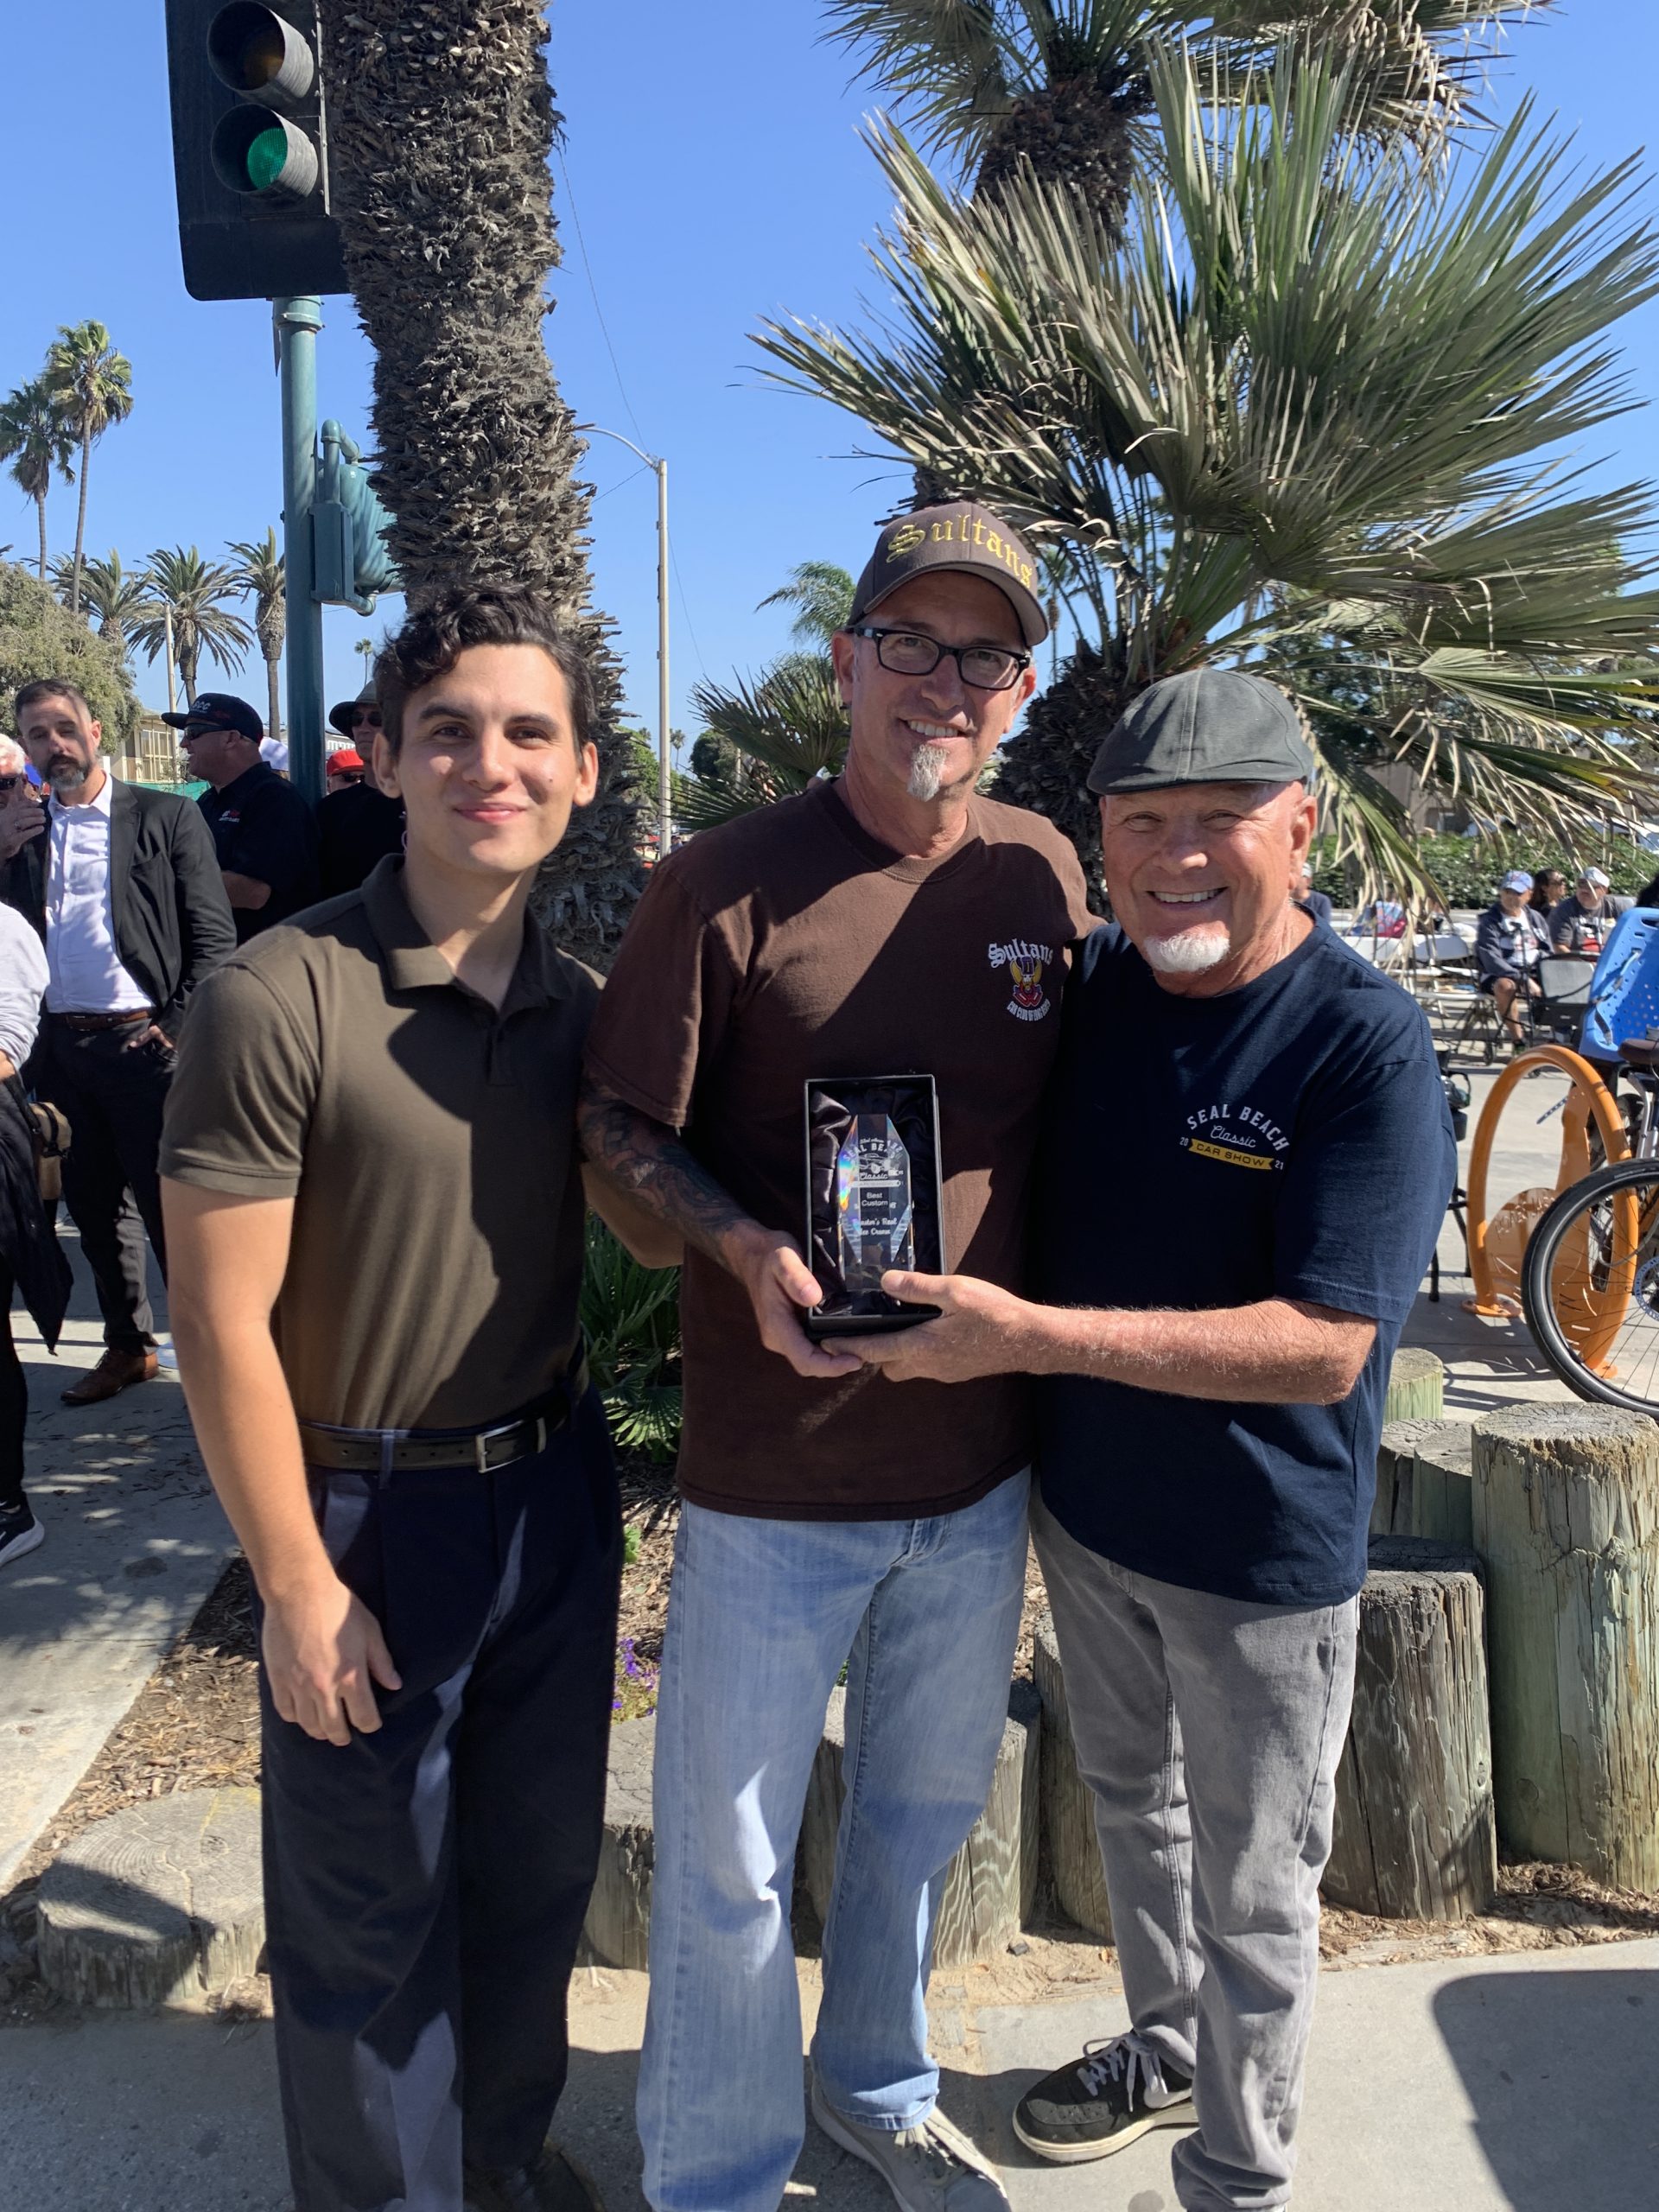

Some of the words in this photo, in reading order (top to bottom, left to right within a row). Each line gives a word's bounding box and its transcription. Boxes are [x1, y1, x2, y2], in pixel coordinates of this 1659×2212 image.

[886, 513, 1033, 588] Sultans
[988, 938, 1054, 969] Sultans
[1186, 1103, 1230, 1130] SEAL
[1238, 1106, 1290, 1151] BEACH
[1210, 1124, 1256, 1148] Classic
[1179, 1136, 1189, 1147] 20
[1196, 1143, 1221, 1156] CAR
[1224, 1151, 1266, 1166] SHOW
[1274, 1160, 1284, 1170] 21
[860, 1172, 888, 1180] Classic
